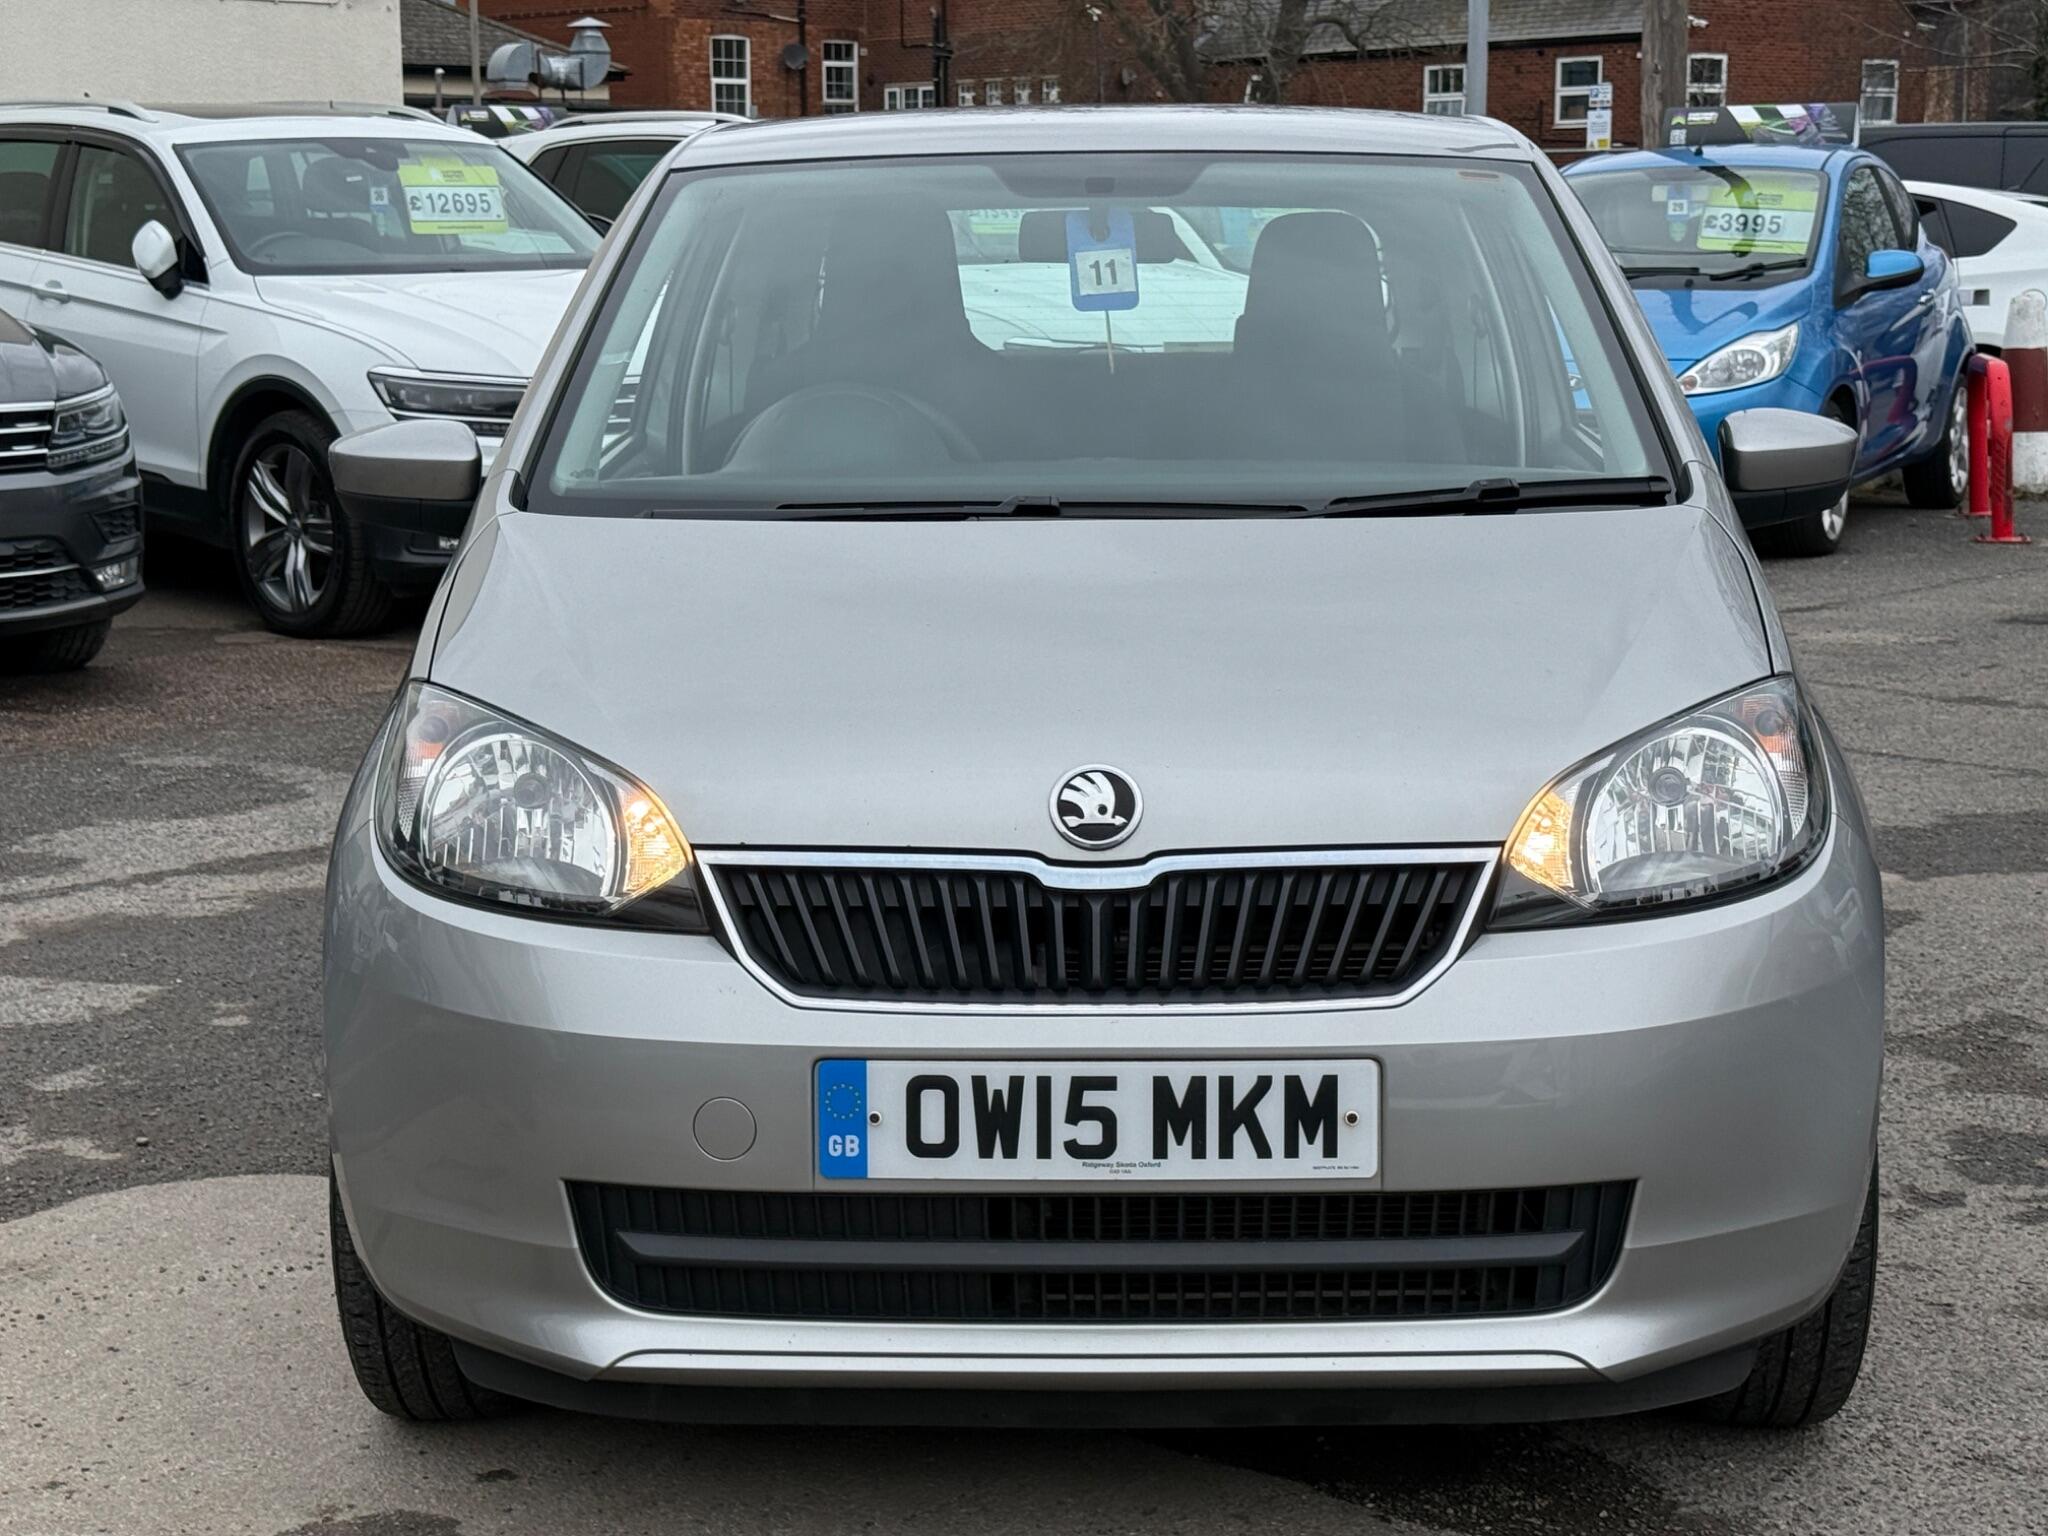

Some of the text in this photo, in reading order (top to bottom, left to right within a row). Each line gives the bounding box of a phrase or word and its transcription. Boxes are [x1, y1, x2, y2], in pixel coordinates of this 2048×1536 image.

[409, 192, 492, 214] £12695
[1704, 212, 1783, 235] £3995
[1088, 259, 1118, 286] 11
[905, 1074, 1339, 1159] OW15 MKM
[828, 1134, 860, 1158] GB
[1081, 1161, 1114, 1169] Ridgeway
